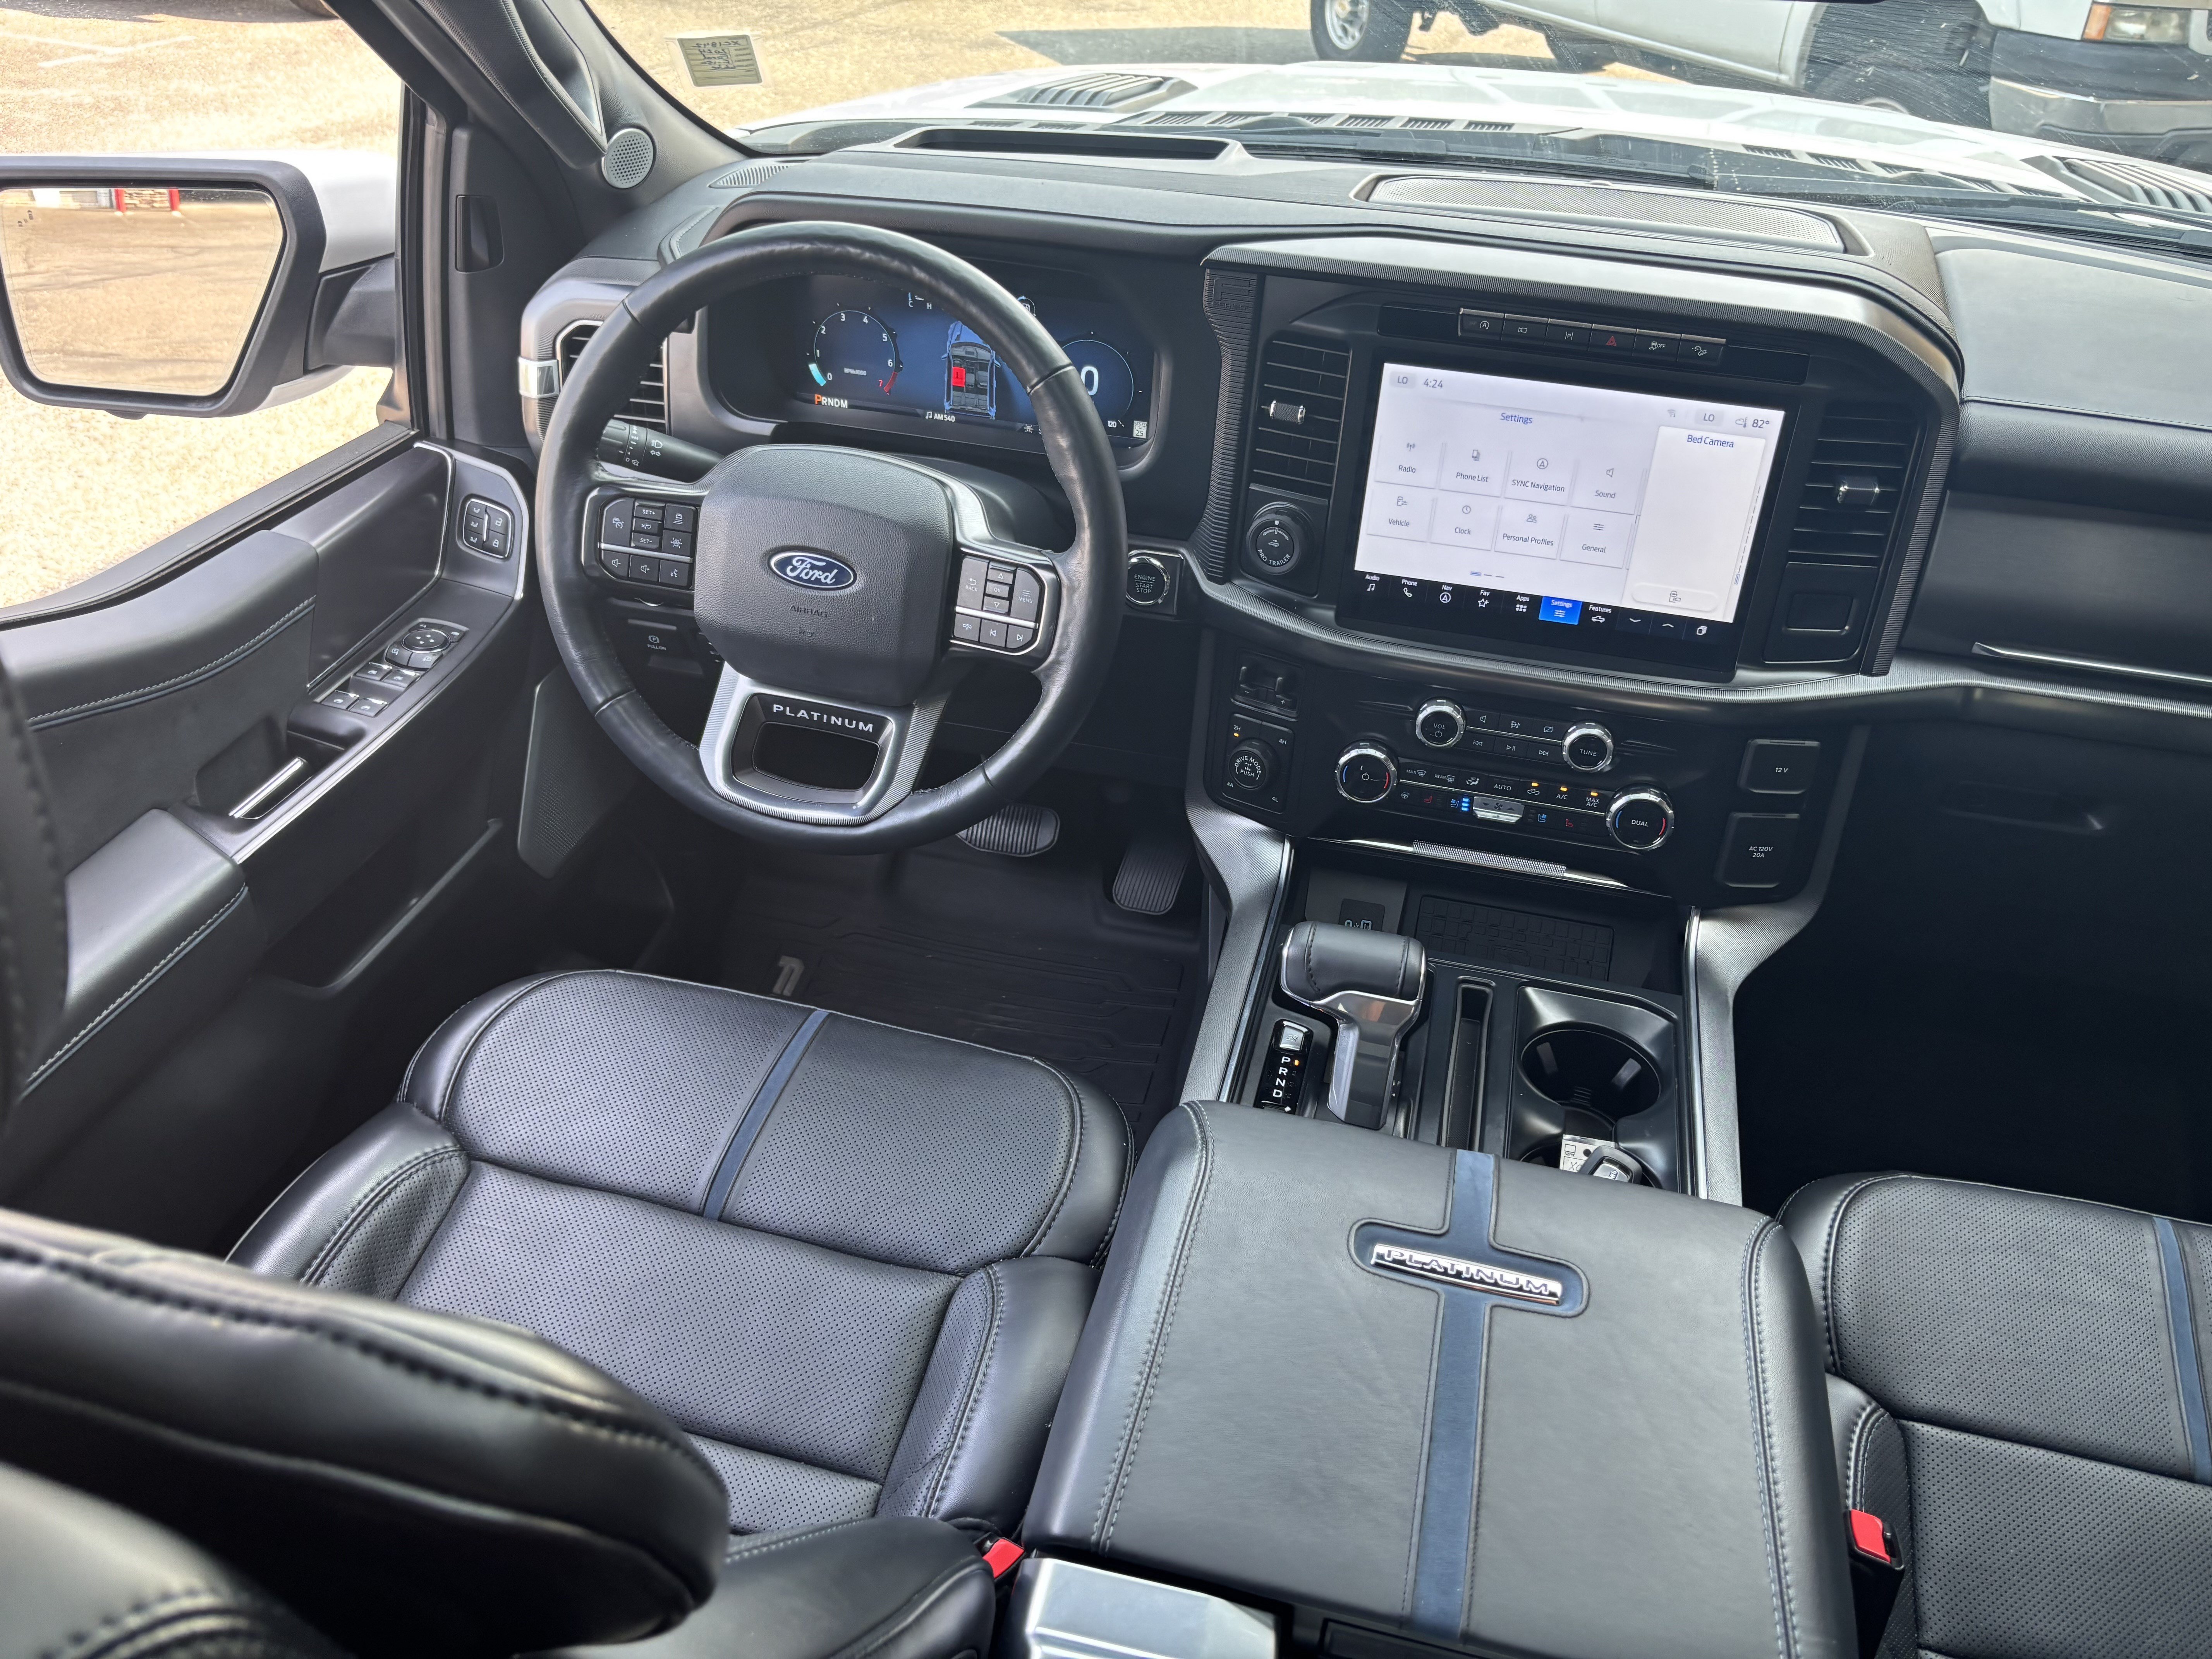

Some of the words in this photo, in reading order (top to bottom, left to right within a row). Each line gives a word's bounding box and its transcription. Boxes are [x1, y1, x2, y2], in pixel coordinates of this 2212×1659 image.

[863, 316, 868, 324] 4
[1398, 376, 1408, 384] LO
[1424, 378, 1443, 389] 4:24
[1500, 412, 1533, 425] Settings
[1704, 414, 1714, 422] LO
[1752, 419, 1769, 428] 82°
[1687, 434, 1702, 444] Bed
[1704, 437, 1734, 448] Camera
[1398, 465, 1416, 473] Radio
[1456, 472, 1476, 481] Phone
[1511, 479, 1529, 488] SYNC
[1530, 482, 1565, 492] Navigation
[1595, 490, 1616, 499] Sound
[1388, 518, 1410, 527] Vehicle
[1503, 533, 1529, 543] Personal
[1530, 537, 1554, 546] Profiles
[1582, 544, 1606, 553] General
[1258, 549, 1267, 562] PRO
[1269, 554, 1291, 566] TRAILER
[787, 556, 838, 584] Ford
[1551, 599, 1573, 608] Settings
[1589, 605, 1611, 613] Features
[789, 605, 828, 618] AIRBAG
[773, 704, 873, 733] PLATINUM
[1235, 756, 1248, 767] DRIVE
[1249, 757, 1261, 773] MODE
[1240, 769, 1254, 777] PUSH
[1278, 1067, 1288, 1076] R
[1275, 1078, 1286, 1087] N
[1273, 1089, 1283, 1097] D
[1385, 1250, 1549, 1295] PLATINUM
